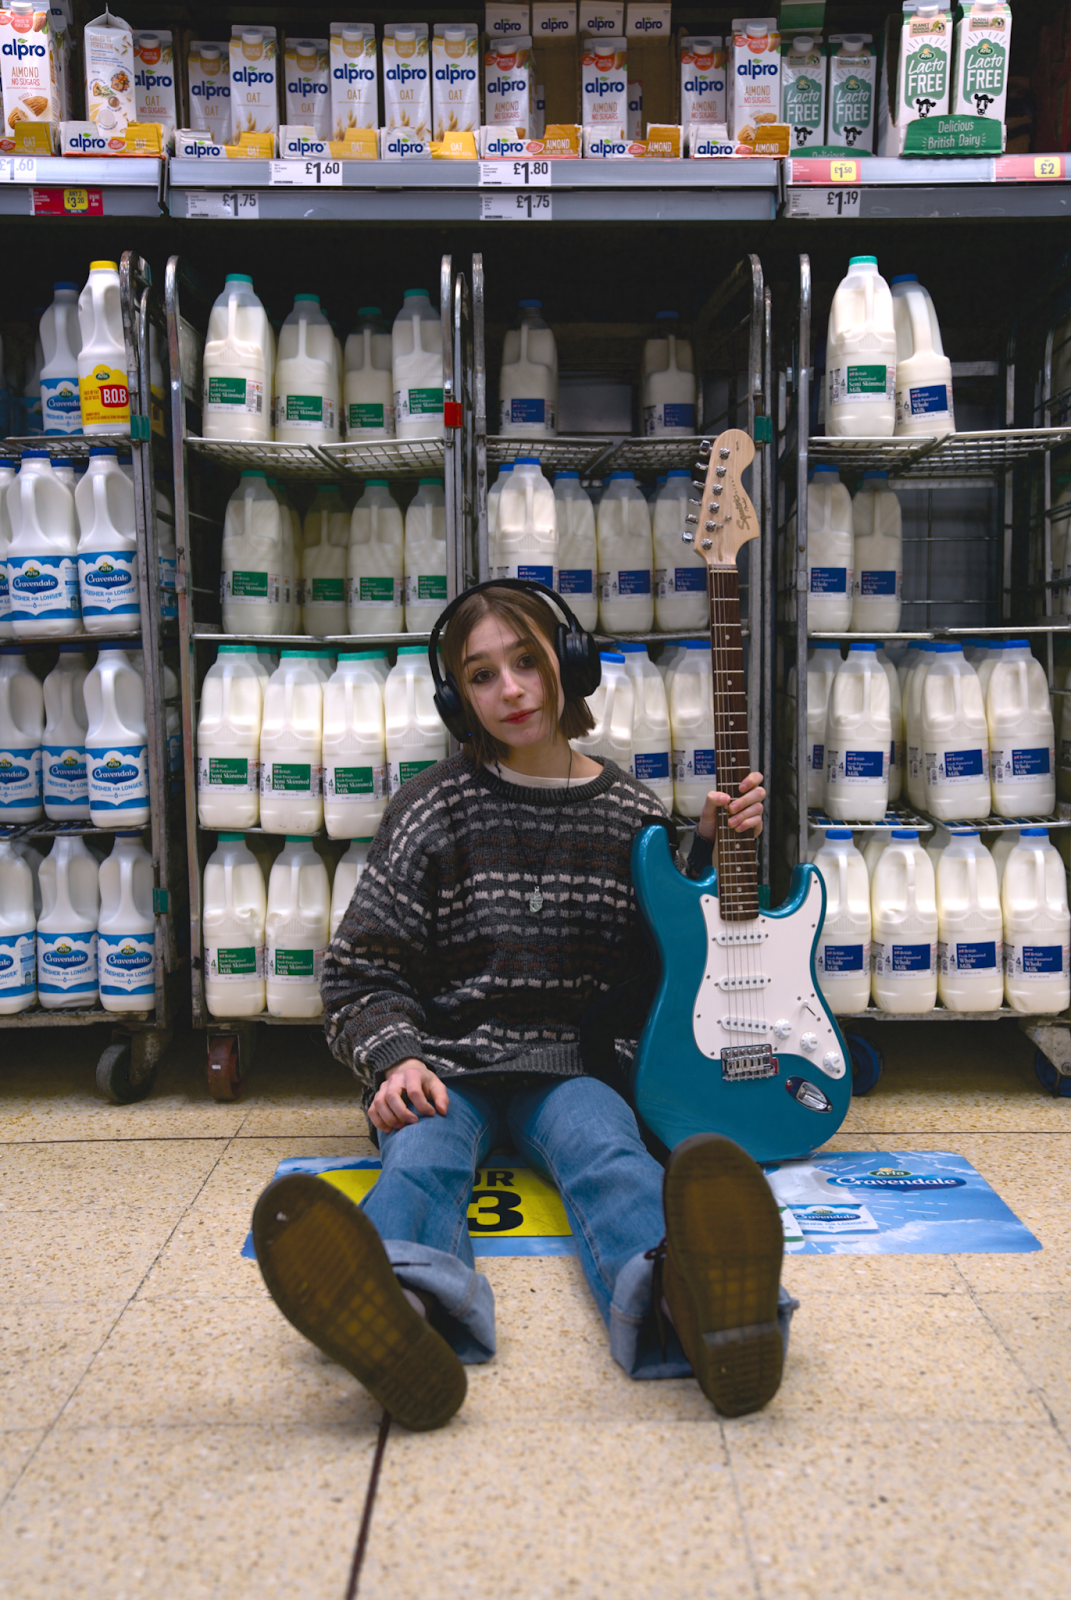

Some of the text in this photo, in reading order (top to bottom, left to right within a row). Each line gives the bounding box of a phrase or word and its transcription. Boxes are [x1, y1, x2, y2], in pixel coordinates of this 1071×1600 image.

[494, 19, 521, 33] alpro
[541, 18, 568, 32] alpro
[588, 17, 615, 30] alpro
[635, 18, 662, 32] alpro
[2, 39, 46, 60] alpro
[908, 58, 945, 74] Lacto
[967, 54, 1004, 69] Lacto
[12, 67, 39, 78] ALMOND
[232, 66, 274, 86] alpro
[334, 64, 374, 84] alpro
[386, 64, 427, 84] alpro
[435, 64, 476, 84] alpro
[737, 59, 778, 80] alpro
[288, 78, 328, 97] alpro
[487, 77, 526, 96] alpro
[585, 77, 625, 97] alpro
[684, 76, 724, 95] alpro
[908, 74, 944, 96] FREE
[967, 70, 1002, 91] FREE
[192, 81, 230, 100] alpro
[246, 92, 260, 102] OAT
[347, 89, 361, 100] OAT
[400, 89, 414, 100] OAT
[448, 90, 463, 100] OAT
[745, 86, 770, 96] ALMOND
[786, 90, 820, 104] Lacto
[836, 90, 870, 104] Lacto
[145, 96, 160, 106] OAT
[301, 103, 315, 113] OAT
[494, 101, 518, 112] ALMOND
[592, 102, 618, 112] ALMOND
[692, 101, 717, 111] ALMOND
[205, 106, 219, 116] OAT
[788, 104, 819, 123] FREE
[836, 104, 868, 123] FREE
[938, 121, 974, 133] Delicious
[23, 137, 35, 147] OAT
[70, 134, 106, 152] alpro
[134, 139, 147, 148] OAT
[288, 138, 324, 156] alpro
[351, 142, 363, 152] OAT
[388, 139, 423, 156] alpro
[450, 142, 463, 151] OAT
[488, 138, 524, 156] alpro
[545, 139, 570, 149] ALMOND
[590, 139, 625, 157] alpro
[647, 142, 672, 152] ALMOND
[698, 141, 733, 156] alpro
[755, 143, 779, 153] ALMOND
[928, 135, 980, 149] British Dairy
[184, 142, 220, 158] alpro
[247, 146, 259, 155] OAT
[0, 158, 34, 180] £1.60
[305, 162, 339, 183] £1.60
[514, 162, 548, 184] £1.80
[835, 167, 852, 178] £1.50
[1041, 163, 1054, 174] £2
[67, 197, 84, 208] £3.20
[222, 194, 256, 216] £1.75
[516, 195, 550, 218] £1.75
[827, 191, 858, 215] £1.19
[103, 388, 127, 404] B.O.B
[904, 401, 909, 410] 6
[14, 580, 55, 588] Cravendale
[87, 574, 128, 583] Cravendale
[94, 769, 136, 778] Cravendale
[45, 954, 86, 963] Cravendale
[108, 955, 150, 964] Cravendale
[837, 1176, 957, 1185] Cravendale
